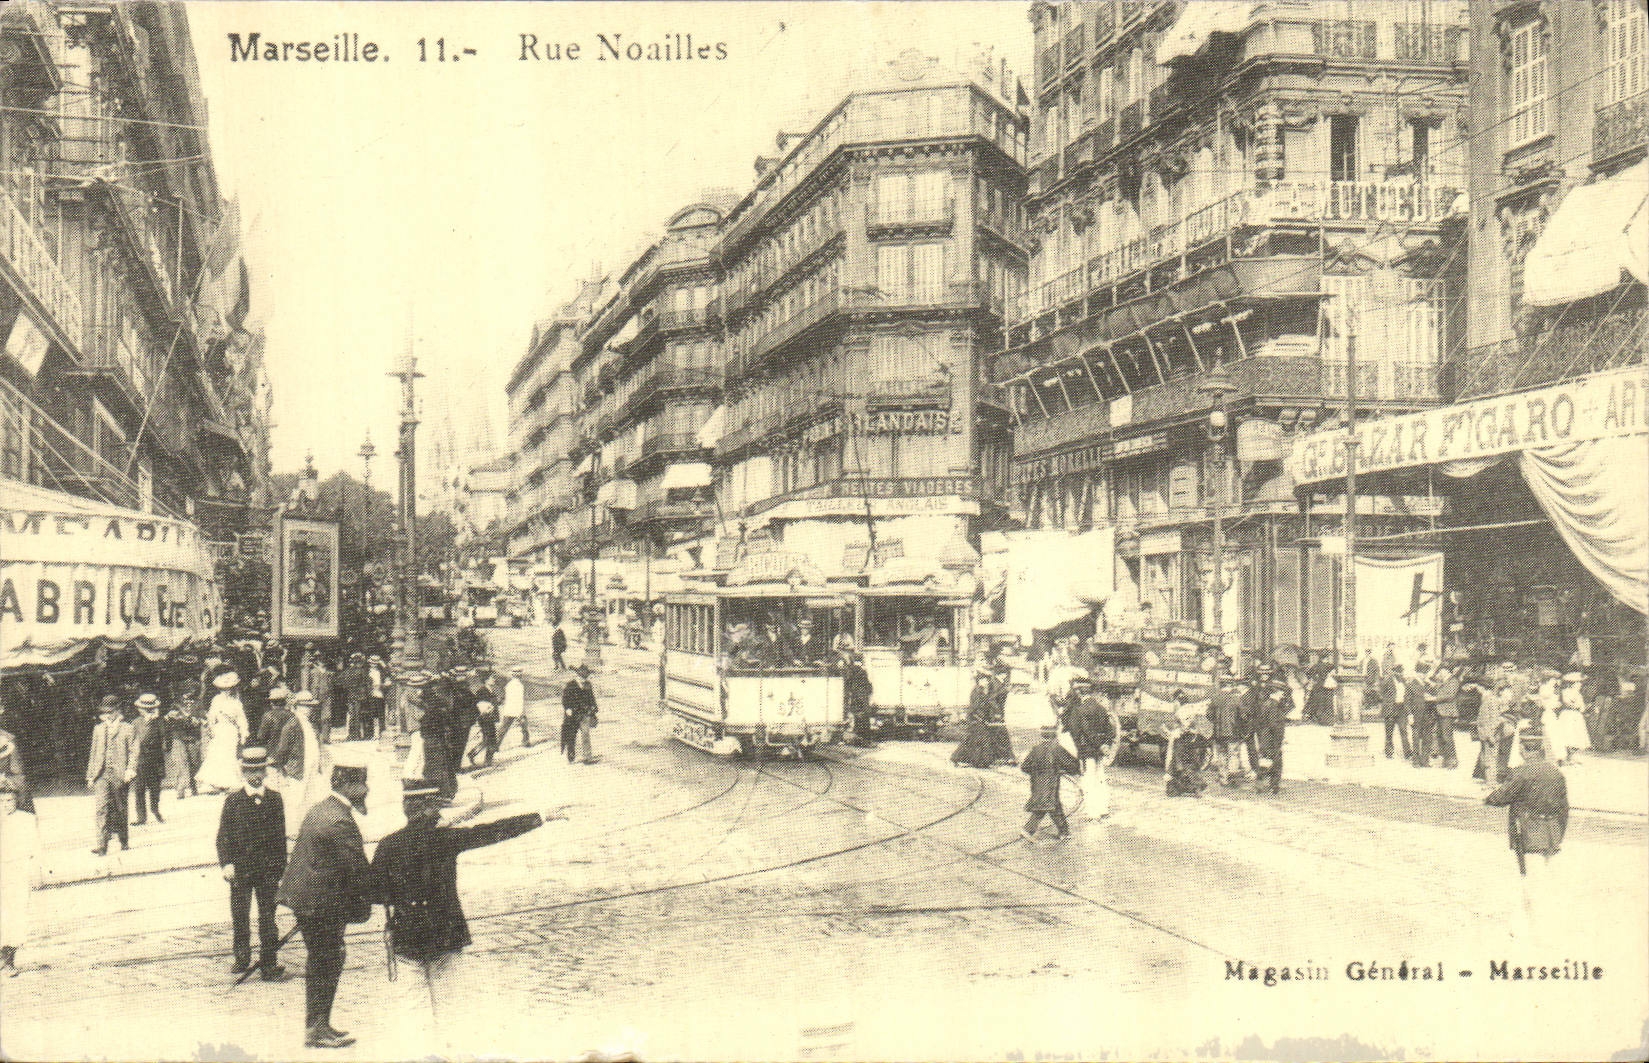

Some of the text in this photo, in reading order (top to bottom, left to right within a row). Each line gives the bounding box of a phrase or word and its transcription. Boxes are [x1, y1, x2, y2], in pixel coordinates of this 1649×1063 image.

[1315, 180, 1448, 221] MUTUELL
[1332, 419, 1428, 474] BAZAR
[1438, 392, 1576, 458] FIGARO
